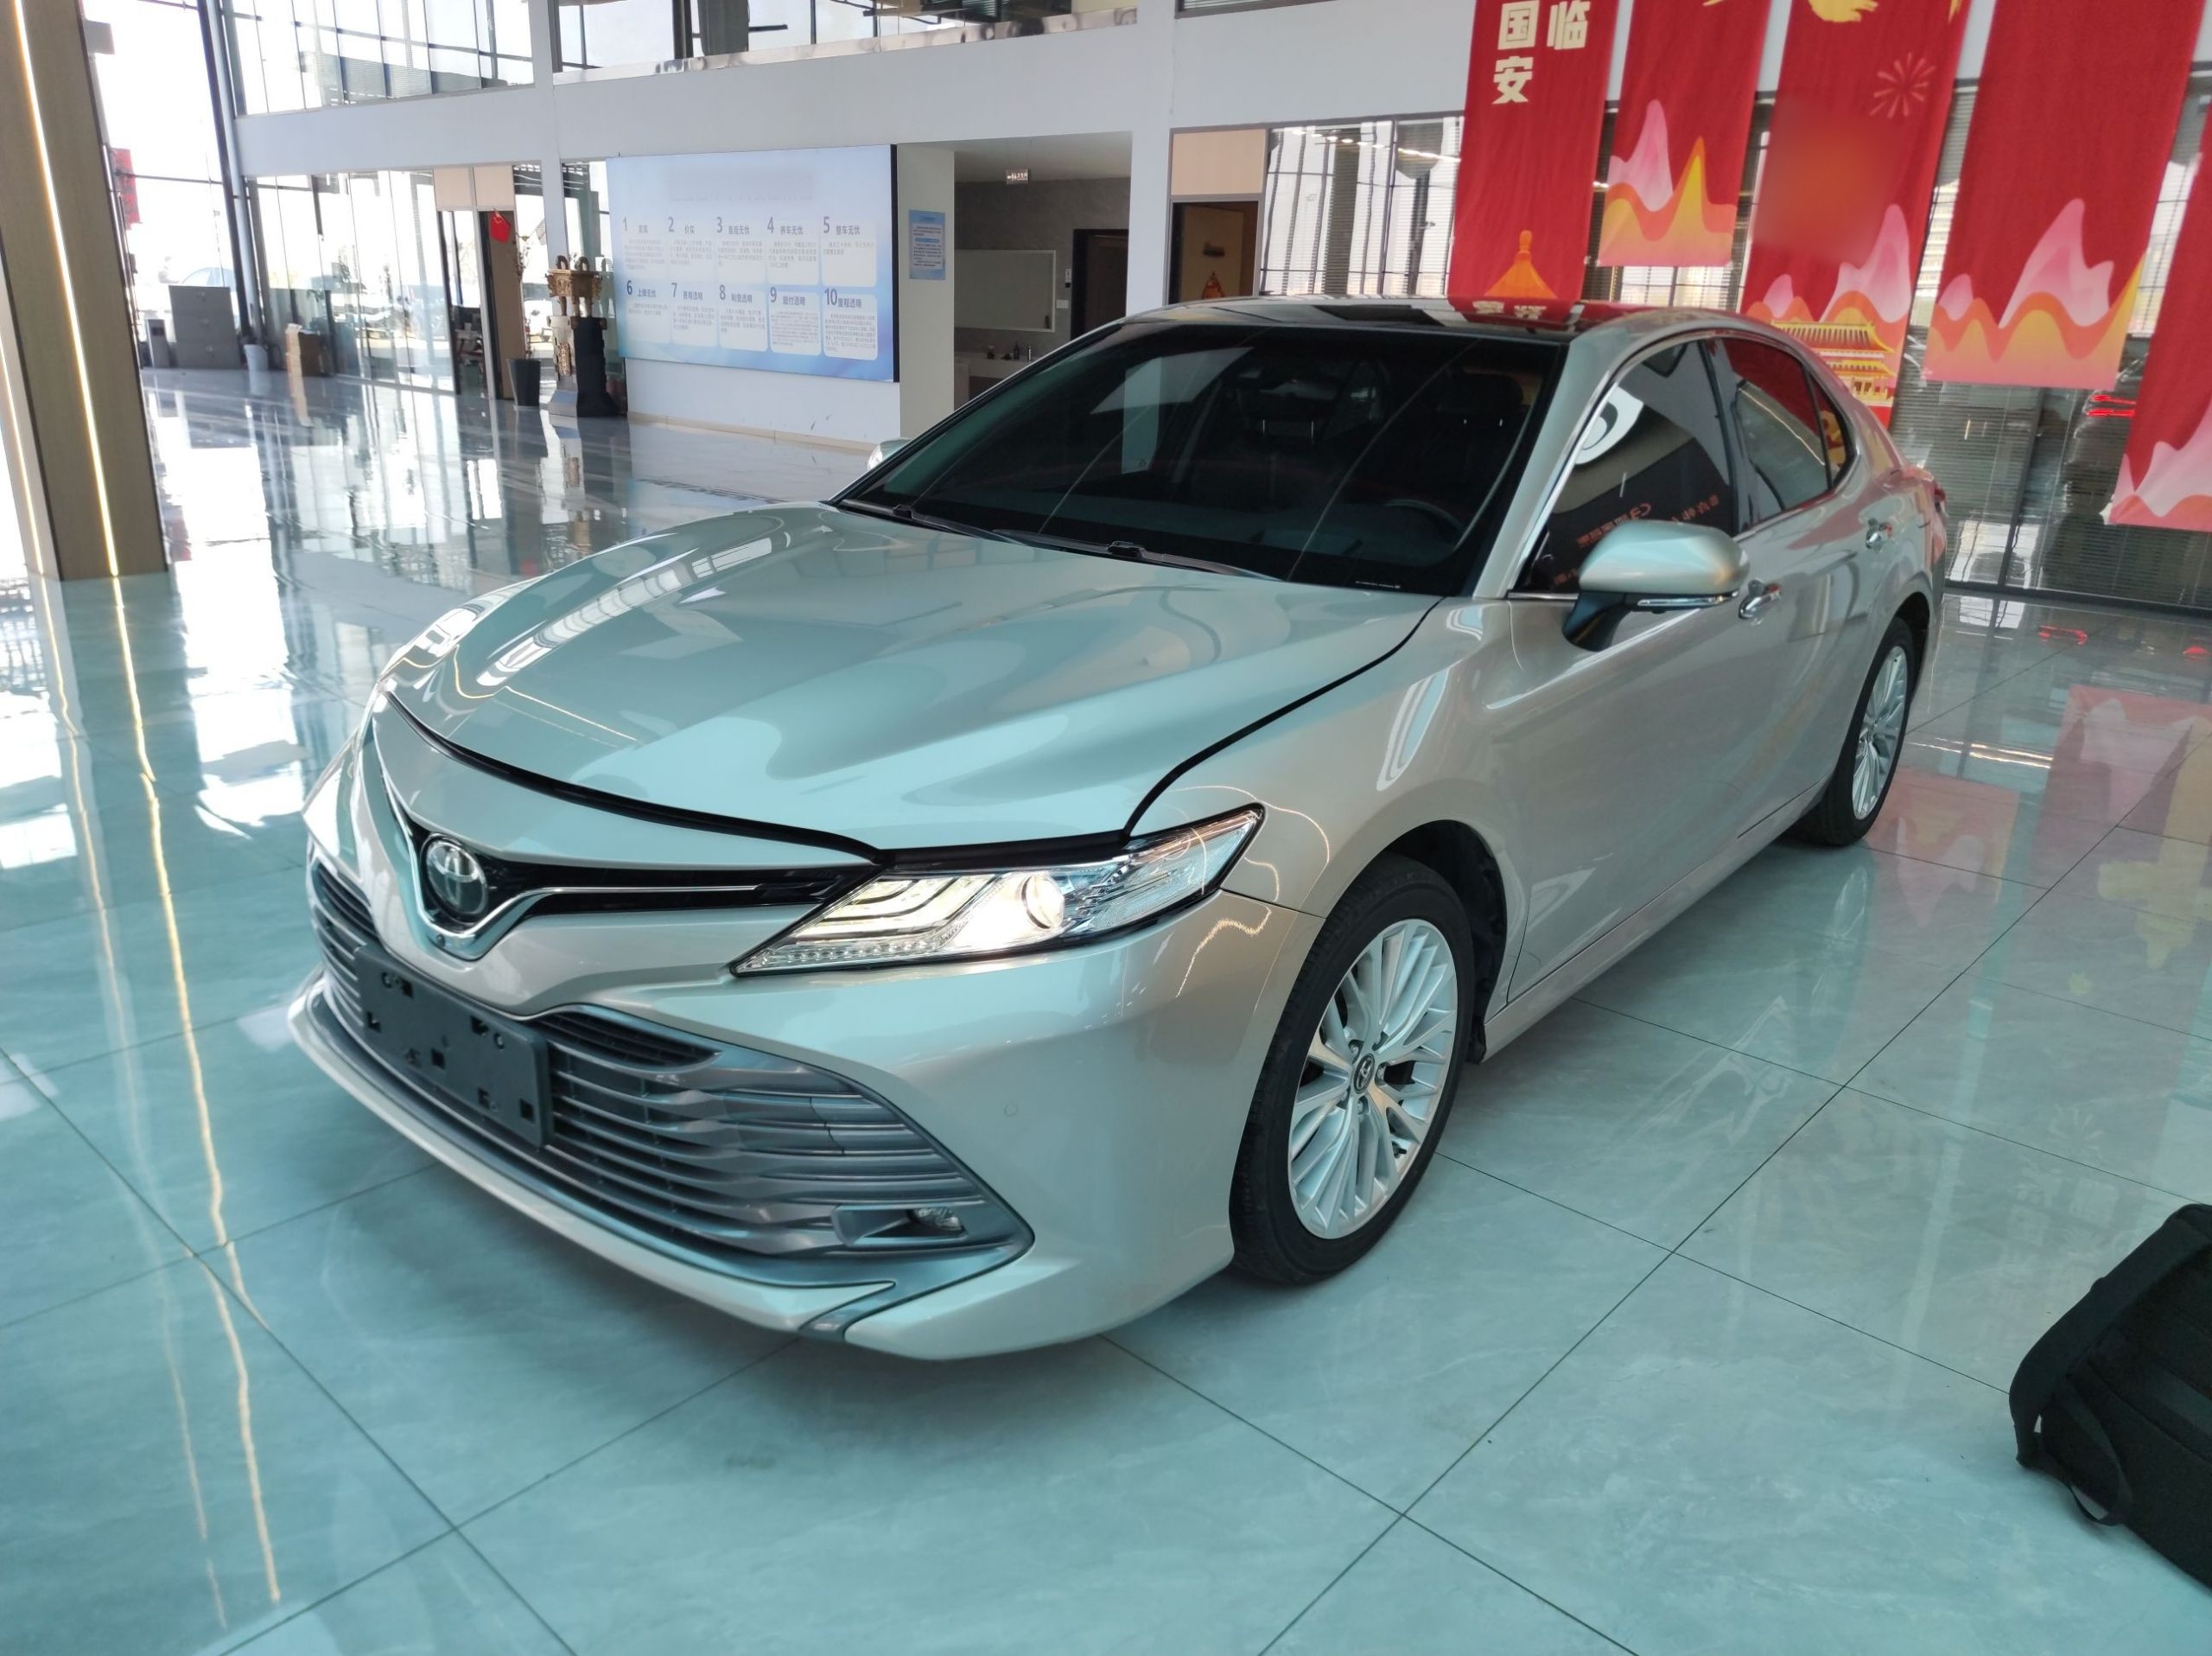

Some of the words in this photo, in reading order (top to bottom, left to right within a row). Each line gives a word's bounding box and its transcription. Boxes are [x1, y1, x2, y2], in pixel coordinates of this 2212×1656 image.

[668, 216, 675, 232] 2
[716, 216, 723, 233] 3
[766, 216, 775, 234] 4
[823, 216, 830, 234] 5
[626, 279, 632, 296] 6
[671, 282, 677, 298] 7
[719, 284, 726, 301] 8
[770, 286, 777, 303] 9
[824, 288, 837, 306] 10
